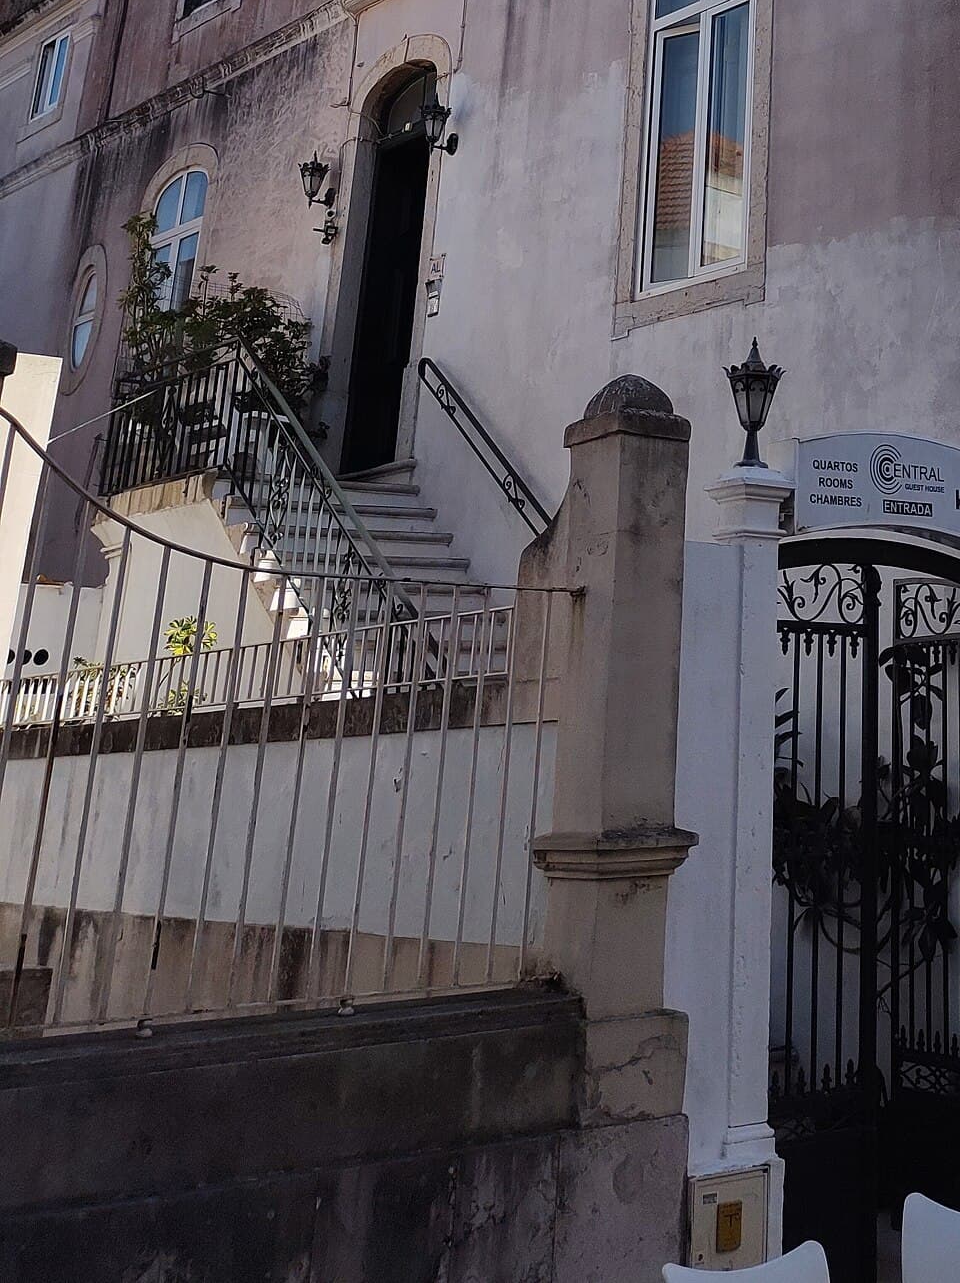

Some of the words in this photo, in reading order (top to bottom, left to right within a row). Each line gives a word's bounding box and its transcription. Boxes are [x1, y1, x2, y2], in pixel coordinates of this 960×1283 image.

[431, 263, 441, 274] AL
[812, 459, 858, 473] QUARTOS
[870, 444, 945, 494] CENTRAL
[818, 476, 854, 490] ROOMS
[904, 483, 924, 492] GUEST
[925, 485, 945, 494] HOUSE
[809, 493, 862, 507] CHAMBRES
[884, 502, 931, 515] ENTRADA
